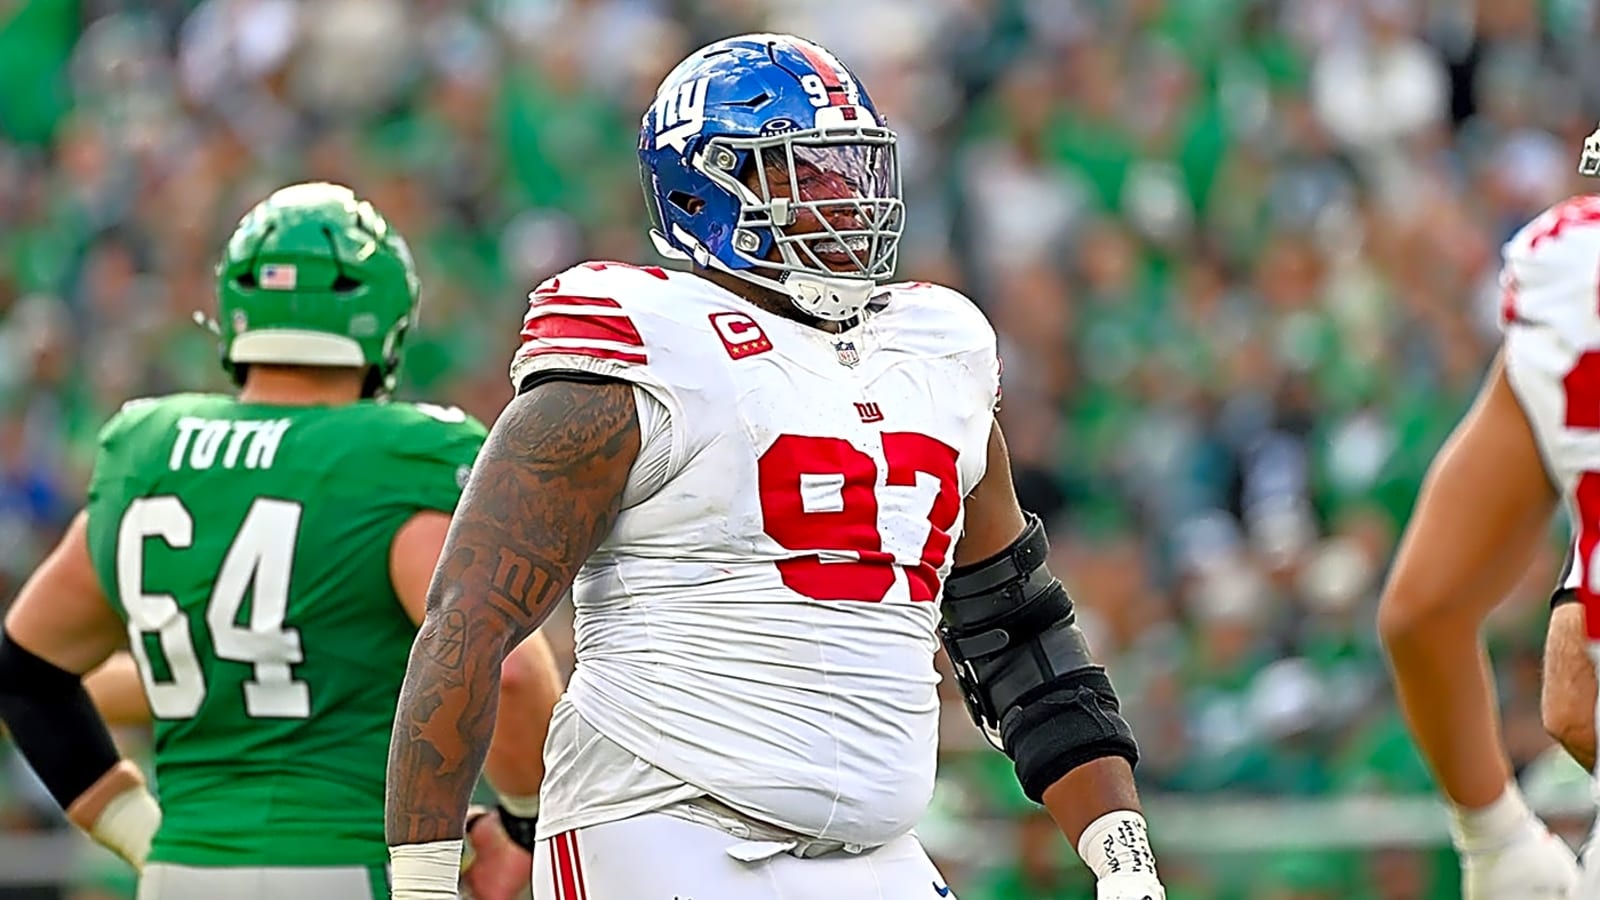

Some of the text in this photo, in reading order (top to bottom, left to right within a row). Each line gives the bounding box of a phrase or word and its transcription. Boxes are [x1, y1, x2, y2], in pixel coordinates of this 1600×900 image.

[714, 313, 762, 345] C
[168, 416, 292, 471] TOTH
[757, 430, 961, 603] 97
[116, 495, 311, 719] 64
